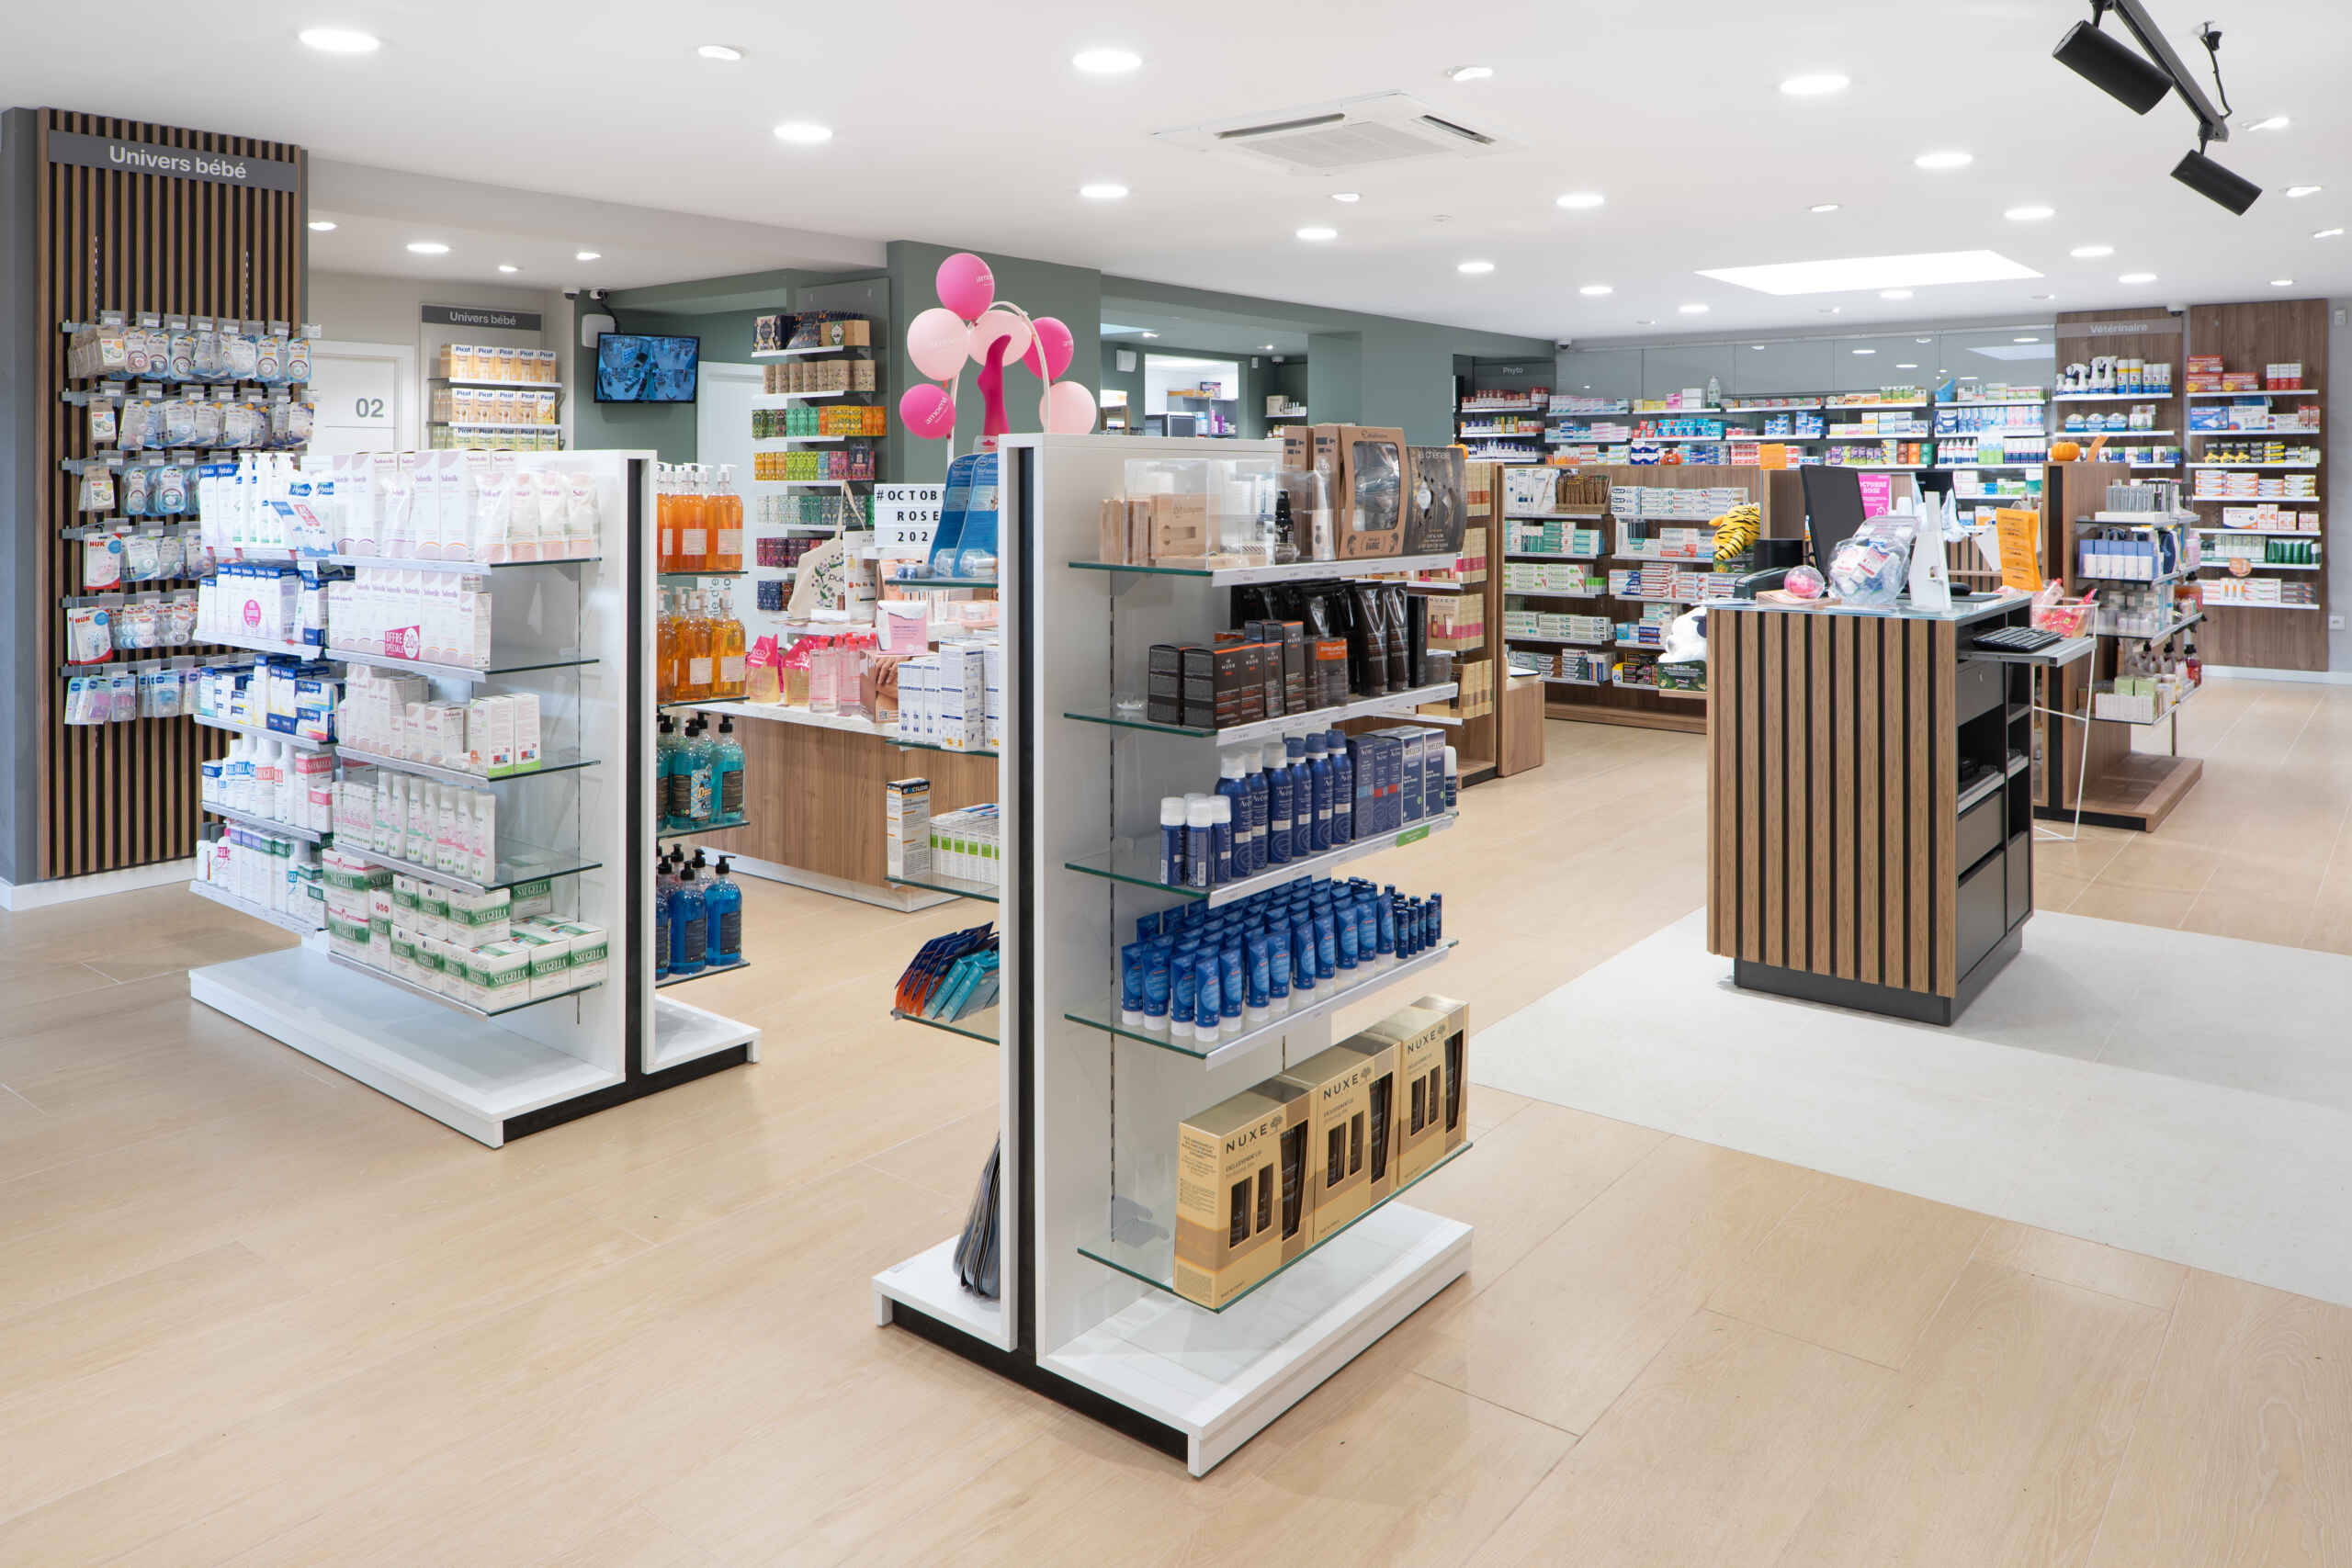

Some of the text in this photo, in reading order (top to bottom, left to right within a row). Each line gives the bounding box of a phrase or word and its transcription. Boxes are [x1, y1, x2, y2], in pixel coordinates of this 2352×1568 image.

[109, 145, 247, 179] Univers bébé
[449, 310, 516, 325] Univers bébé
[2090, 322, 2148, 333] Vétérinaire
[356, 398, 384, 418] 02
[897, 511, 940, 522] ROSE
[89, 539, 105, 547] NUK
[74, 615, 91, 624] NUK
[516, 882, 548, 898] SAUGELLA
[475, 908, 508, 924] SAUGELLA
[574, 946, 605, 964] SAUGELLA
[535, 958, 567, 974] SAUGELLA
[493, 968, 527, 987] SAUGELLA
[1407, 1030, 1436, 1055] NUXE
[1323, 1073, 1359, 1100] NUXE
[1226, 1123, 1267, 1155] NUXE
